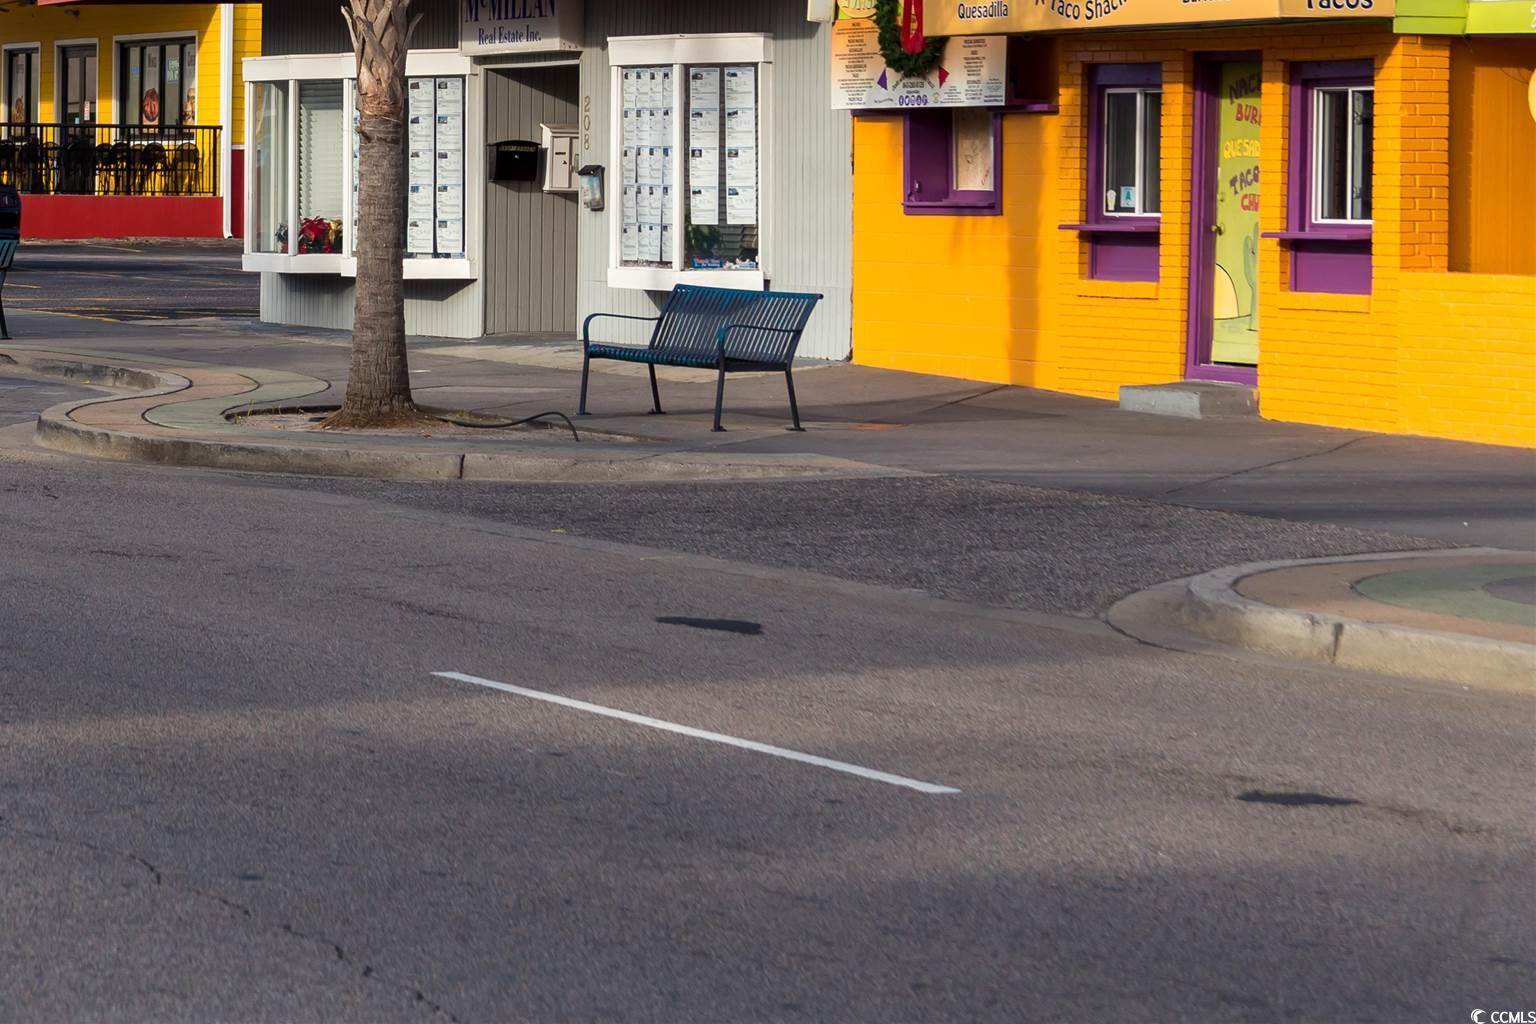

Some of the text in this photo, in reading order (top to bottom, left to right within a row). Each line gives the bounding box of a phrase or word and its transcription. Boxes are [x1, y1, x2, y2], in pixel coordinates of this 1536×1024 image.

[958, 0, 1008, 19] Quesadilla
[478, 24, 542, 45] Real Estate Inc.
